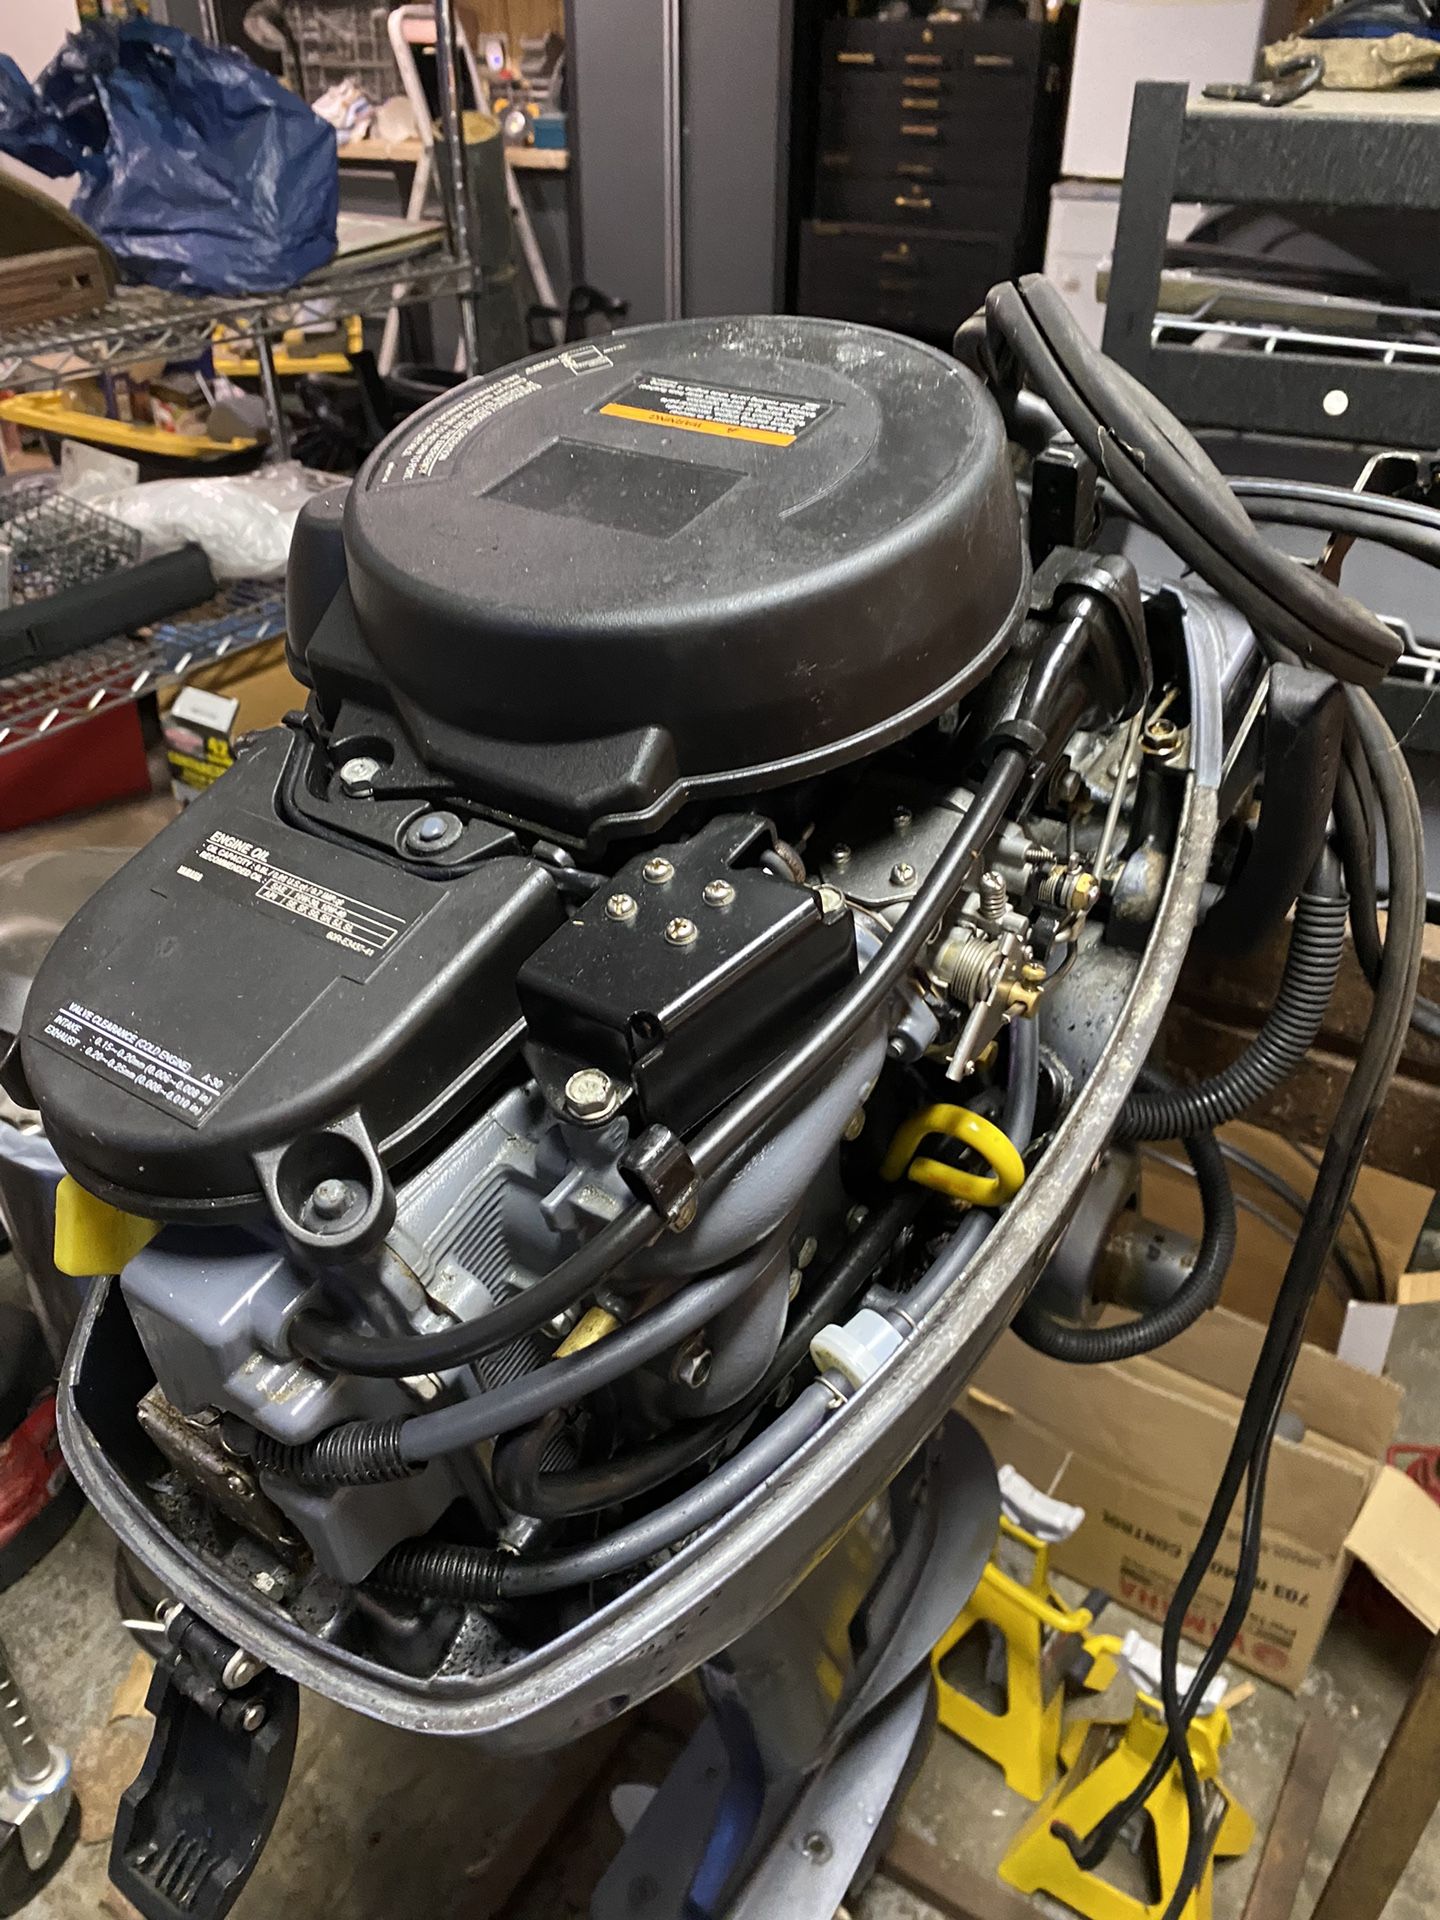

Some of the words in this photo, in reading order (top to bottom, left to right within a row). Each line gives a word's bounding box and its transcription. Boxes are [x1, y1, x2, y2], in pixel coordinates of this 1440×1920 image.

[206, 844, 219, 854] OIL
[217, 849, 253, 867] CAPACITY
[210, 831, 253, 855] ENGINE
[250, 847, 270, 862] OIL
[198, 850, 252, 878] RECOMMENDED
[249, 872, 262, 883] OIL
[270, 882, 288, 894] SAE
[44, 1024, 81, 1048] EXHAUST
[54, 1015, 83, 1034] INTAKE
[69, 1002, 94, 1020] VALVE
[91, 1015, 139, 1044] CLEARANCE
[134, 1039, 161, 1055] (COLD
[158, 1050, 192, 1073] ENGINE)
